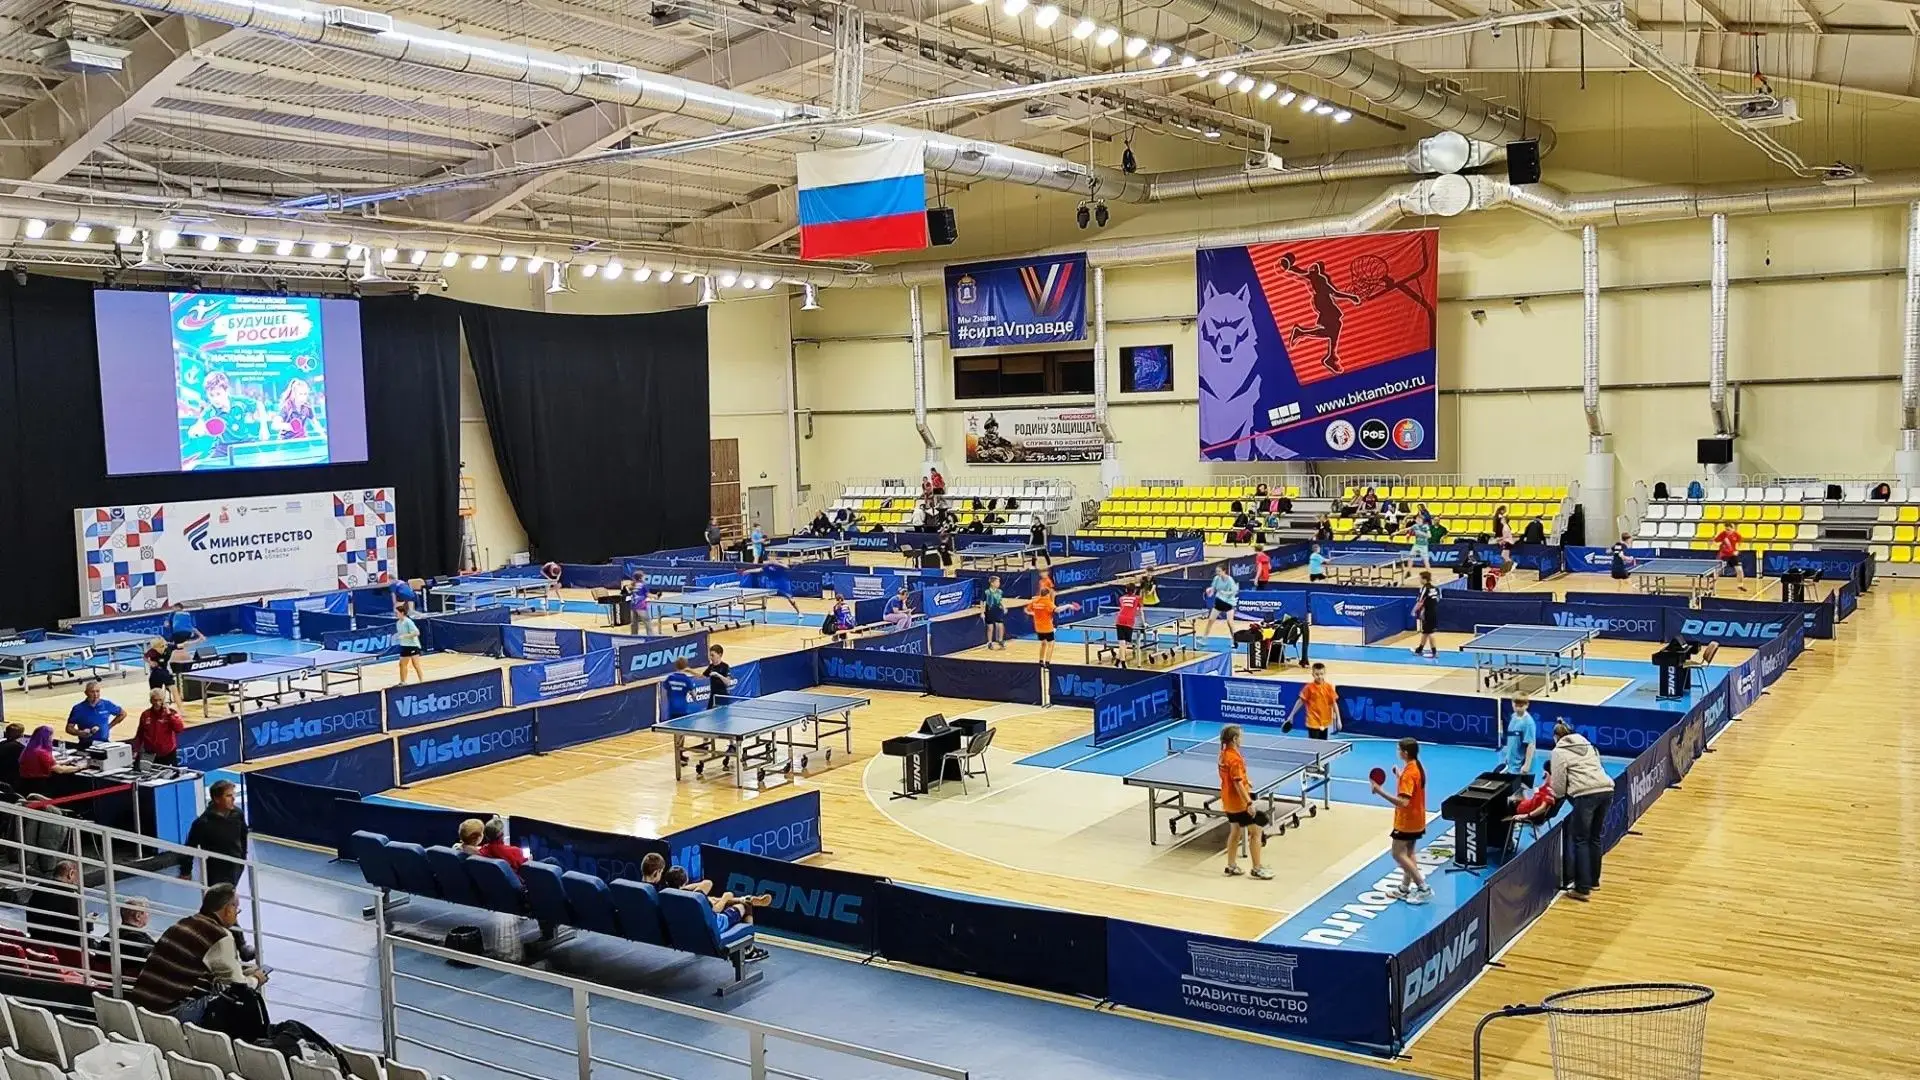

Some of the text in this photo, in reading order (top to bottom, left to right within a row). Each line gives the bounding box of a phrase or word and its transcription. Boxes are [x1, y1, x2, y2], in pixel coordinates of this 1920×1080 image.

[228, 315, 288, 329] БУДУЩЕЕ
[957, 319, 1074, 340] #силаVправде
[237, 326, 299, 341] РОССИИ
[1315, 375, 1426, 414] www.bktambov.ru
[1015, 422, 1048, 435] РОДИНУ
[1363, 430, 1386, 439] РФБ
[210, 530, 313, 549] МИНИСТЕРСТВО
[210, 549, 263, 565] СПОРТА
[1553, 611, 1656, 633] VistaSPORT
[1681, 619, 1783, 638] DONIC
[191, 659, 224, 670] DONIC
[630, 643, 698, 671] DONIC
[301, 671, 308, 681] 2
[824, 657, 923, 684] VistaSPORT
[395, 685, 494, 717] VistaSPORT
[1220, 705, 1286, 716] ПРАВИТЕЛЬСТВО
[800, 719, 809, 732] 3
[1346, 696, 1496, 735] VistaSPORT
[251, 708, 376, 747] VistaSPORT
[409, 724, 532, 767] VistaSPORT
[913, 753, 923, 791] ONIC
[726, 872, 862, 924] DONIC
[1402, 918, 1479, 1013] DONIC
[1181, 984, 1308, 1013] ПРАВИТЕЛЬСТВО
[1184, 997, 1308, 1024] ТАМБОВСКОЙ ОБЛАСТИ
